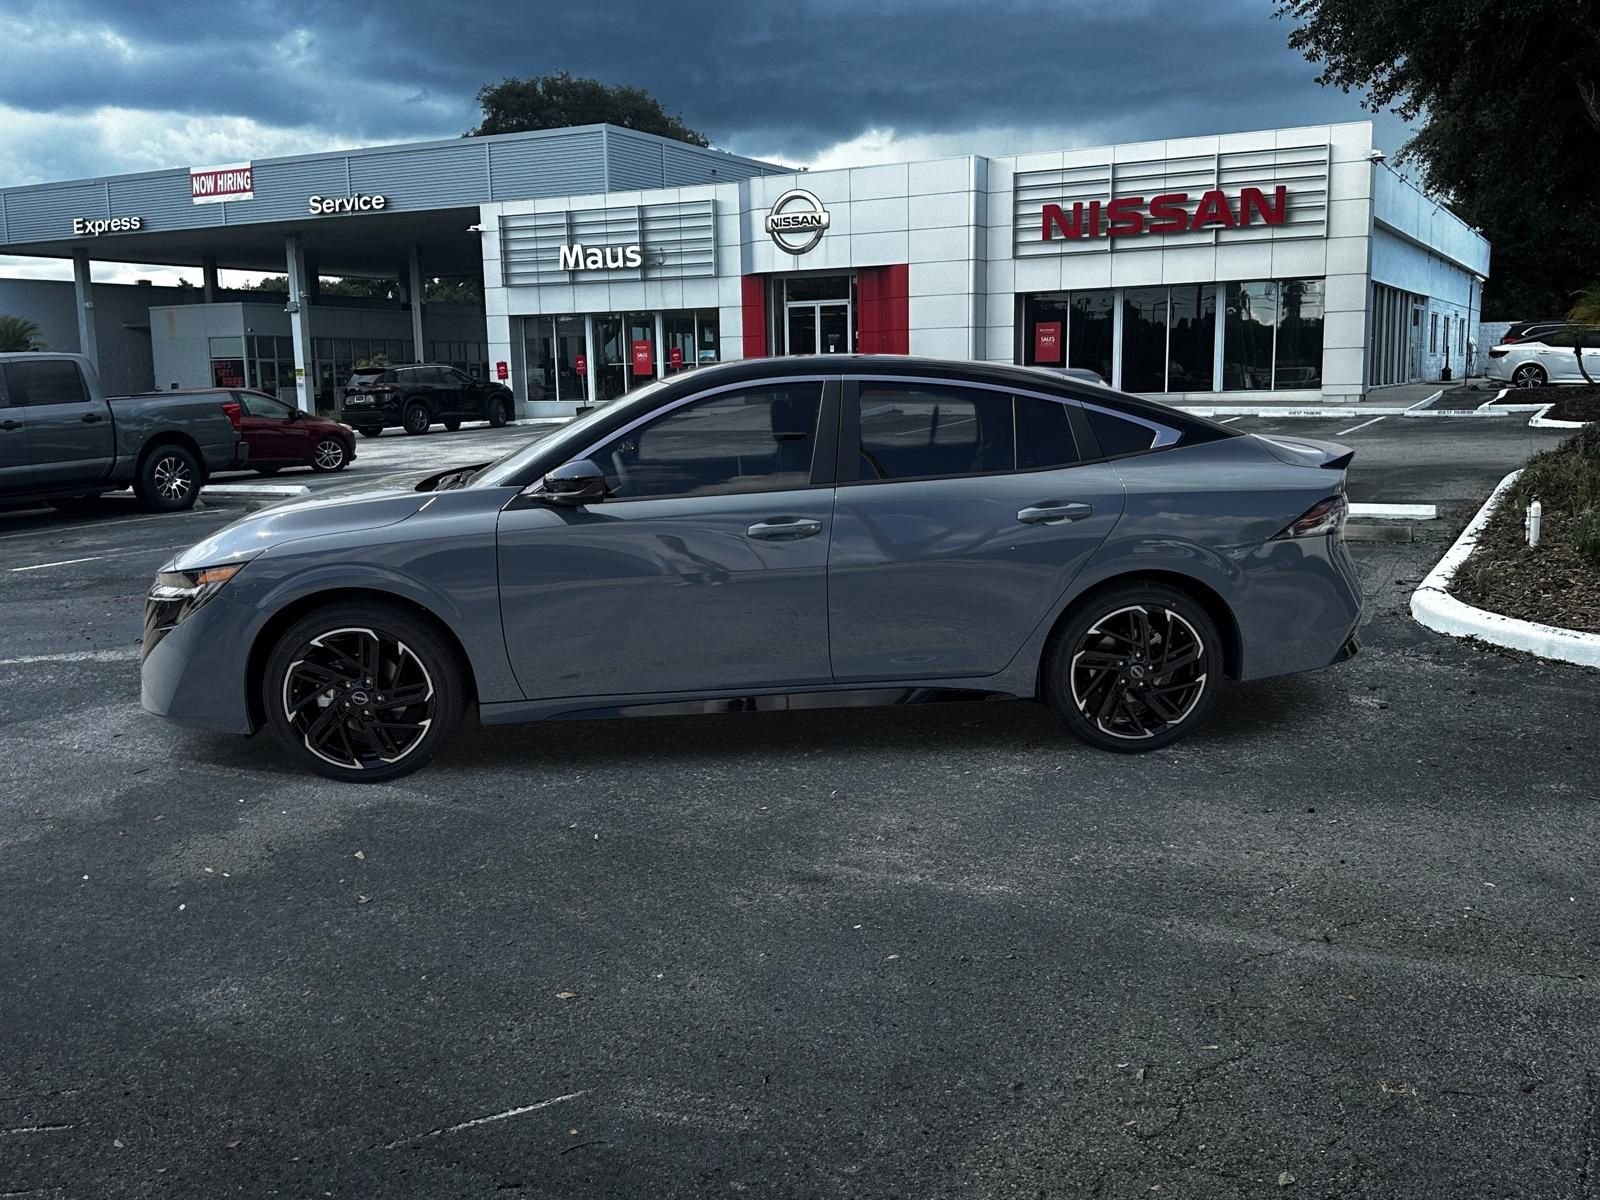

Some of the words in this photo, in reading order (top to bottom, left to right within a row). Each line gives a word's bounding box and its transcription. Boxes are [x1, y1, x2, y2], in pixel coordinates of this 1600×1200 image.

[193, 174, 215, 194] NOW
[217, 171, 251, 192] HIRING
[309, 193, 385, 214] Service
[1042, 185, 1287, 241] NISSAN
[73, 216, 141, 236] Express
[770, 215, 821, 228] NISSAN
[560, 243, 642, 271] Maus
